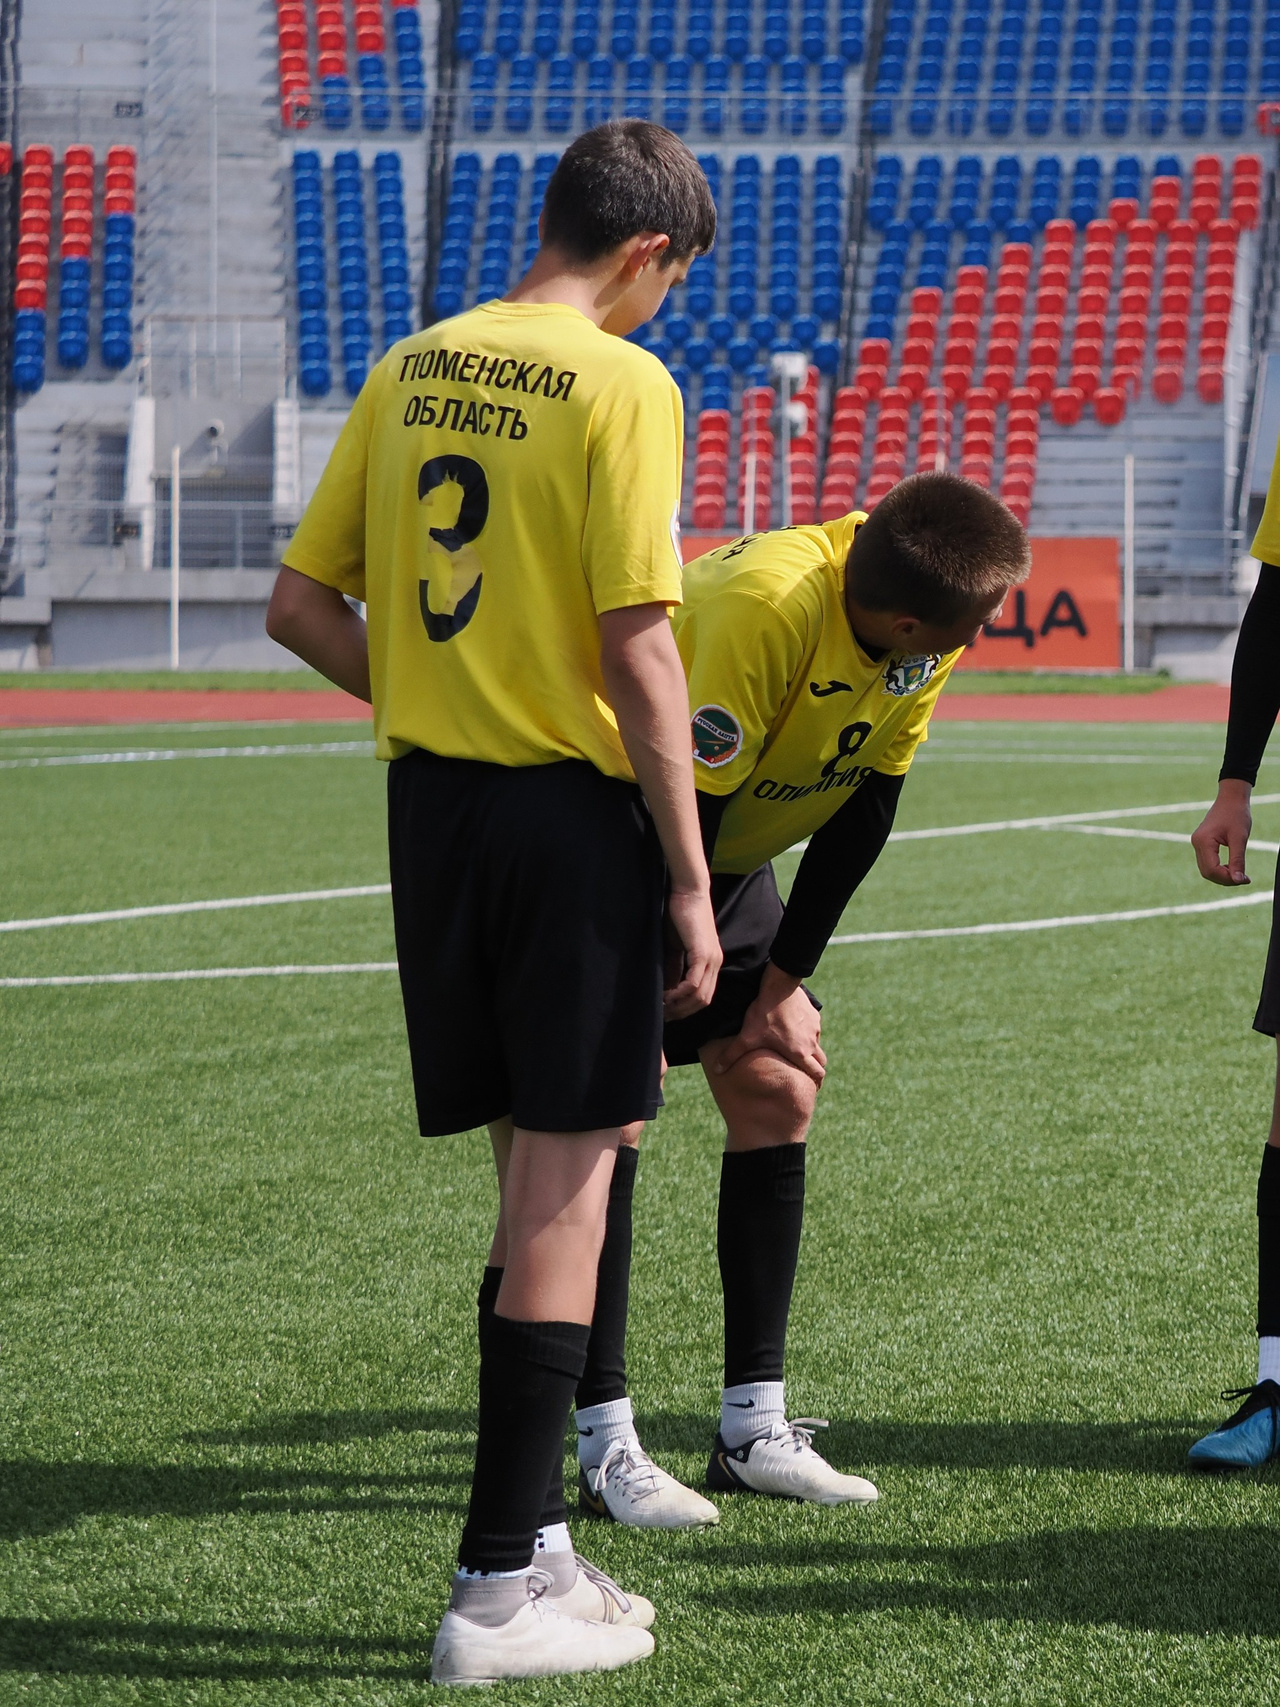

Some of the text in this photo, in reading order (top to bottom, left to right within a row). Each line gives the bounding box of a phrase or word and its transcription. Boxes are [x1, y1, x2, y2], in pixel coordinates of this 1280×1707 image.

[399, 348, 579, 402] ТЮМЕНСКАЯ
[403, 395, 528, 441] ОБЛАСТЬ
[417, 453, 490, 643] 3
[968, 589, 1088, 648] ЦА
[820, 721, 873, 778] 8
